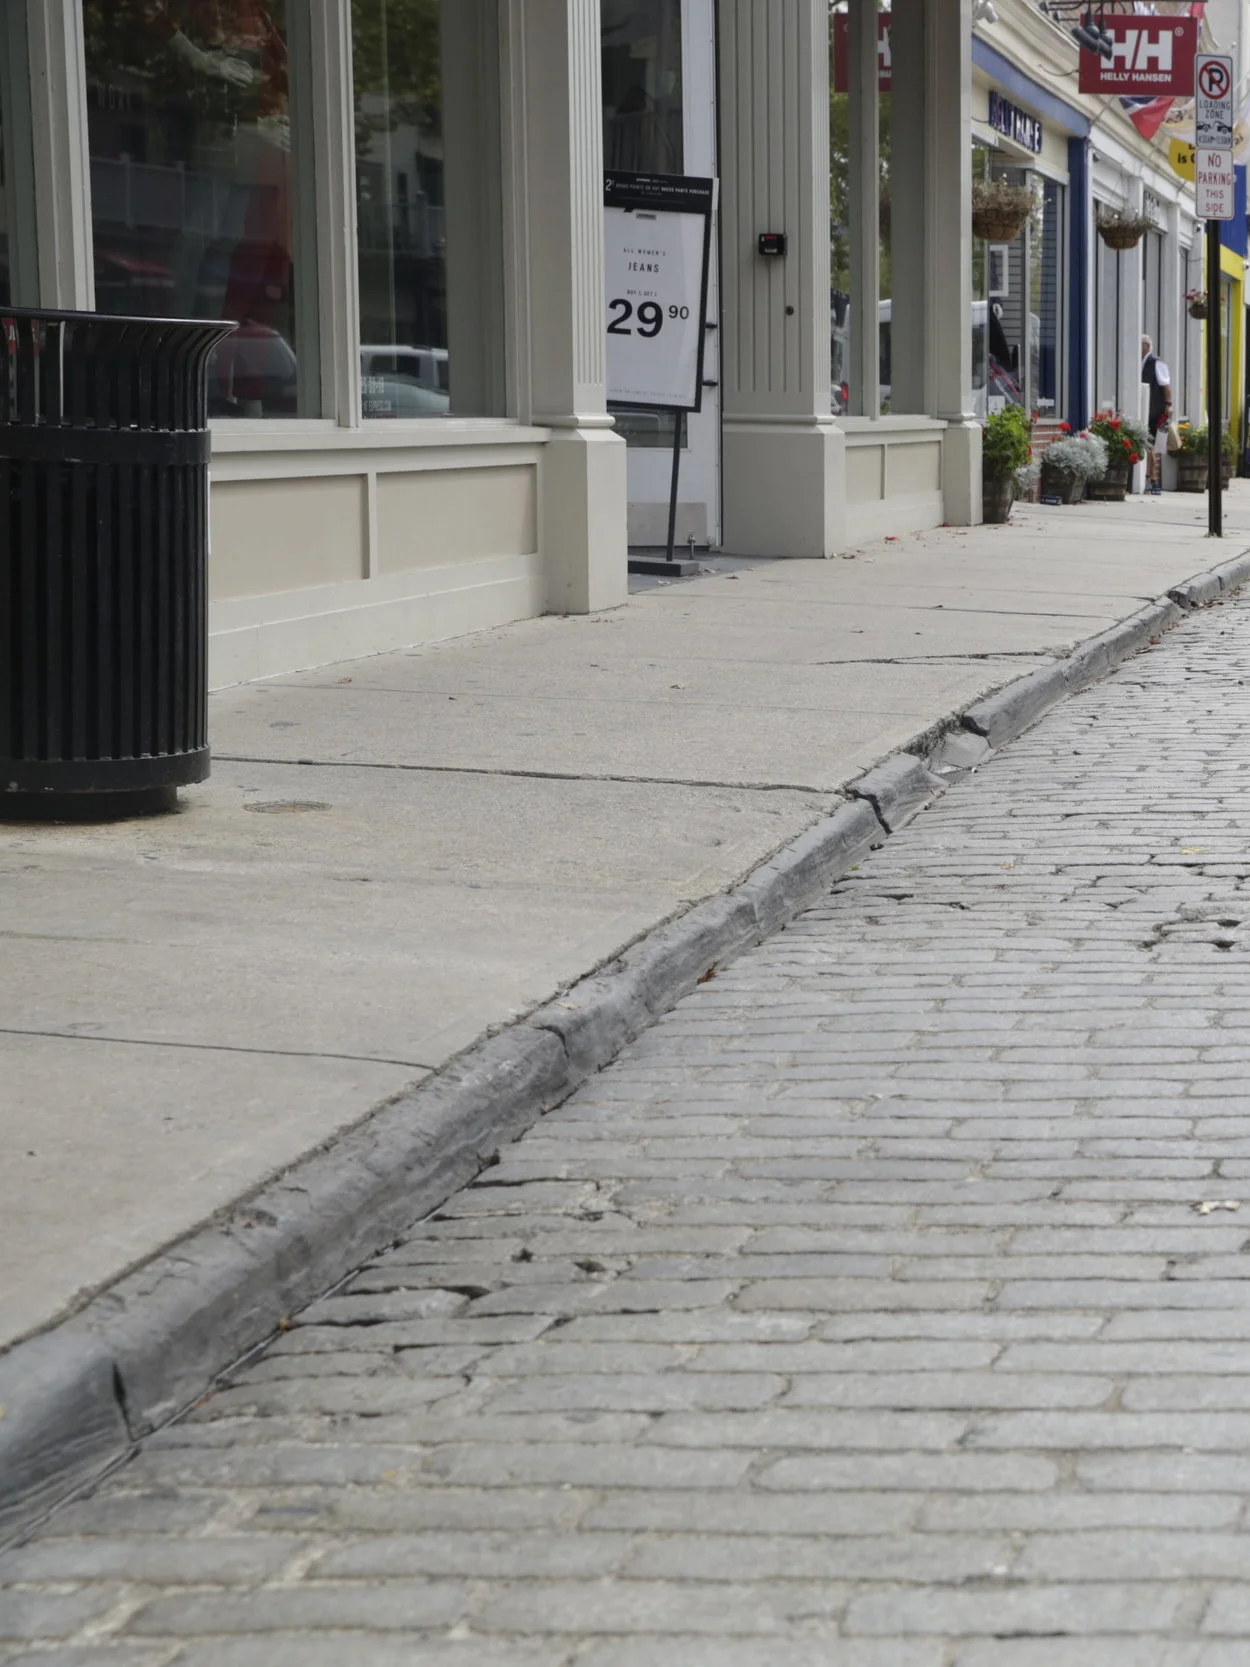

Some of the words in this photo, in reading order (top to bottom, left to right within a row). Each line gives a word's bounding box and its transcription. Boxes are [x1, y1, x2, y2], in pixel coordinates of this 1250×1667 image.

[1100, 71, 1130, 81] HELLY
[1131, 72, 1172, 83] HANSEN
[1199, 99, 1231, 111] LOADING
[1205, 109, 1225, 120] ZONE
[1207, 154, 1222, 168] NO
[1198, 171, 1231, 186] PARKING
[1206, 188, 1224, 199] THIS
[1205, 202, 1224, 213] SIDE
[628, 261, 660, 273] JEANS
[606, 298, 664, 338] 29
[668, 305, 690, 320] 90
